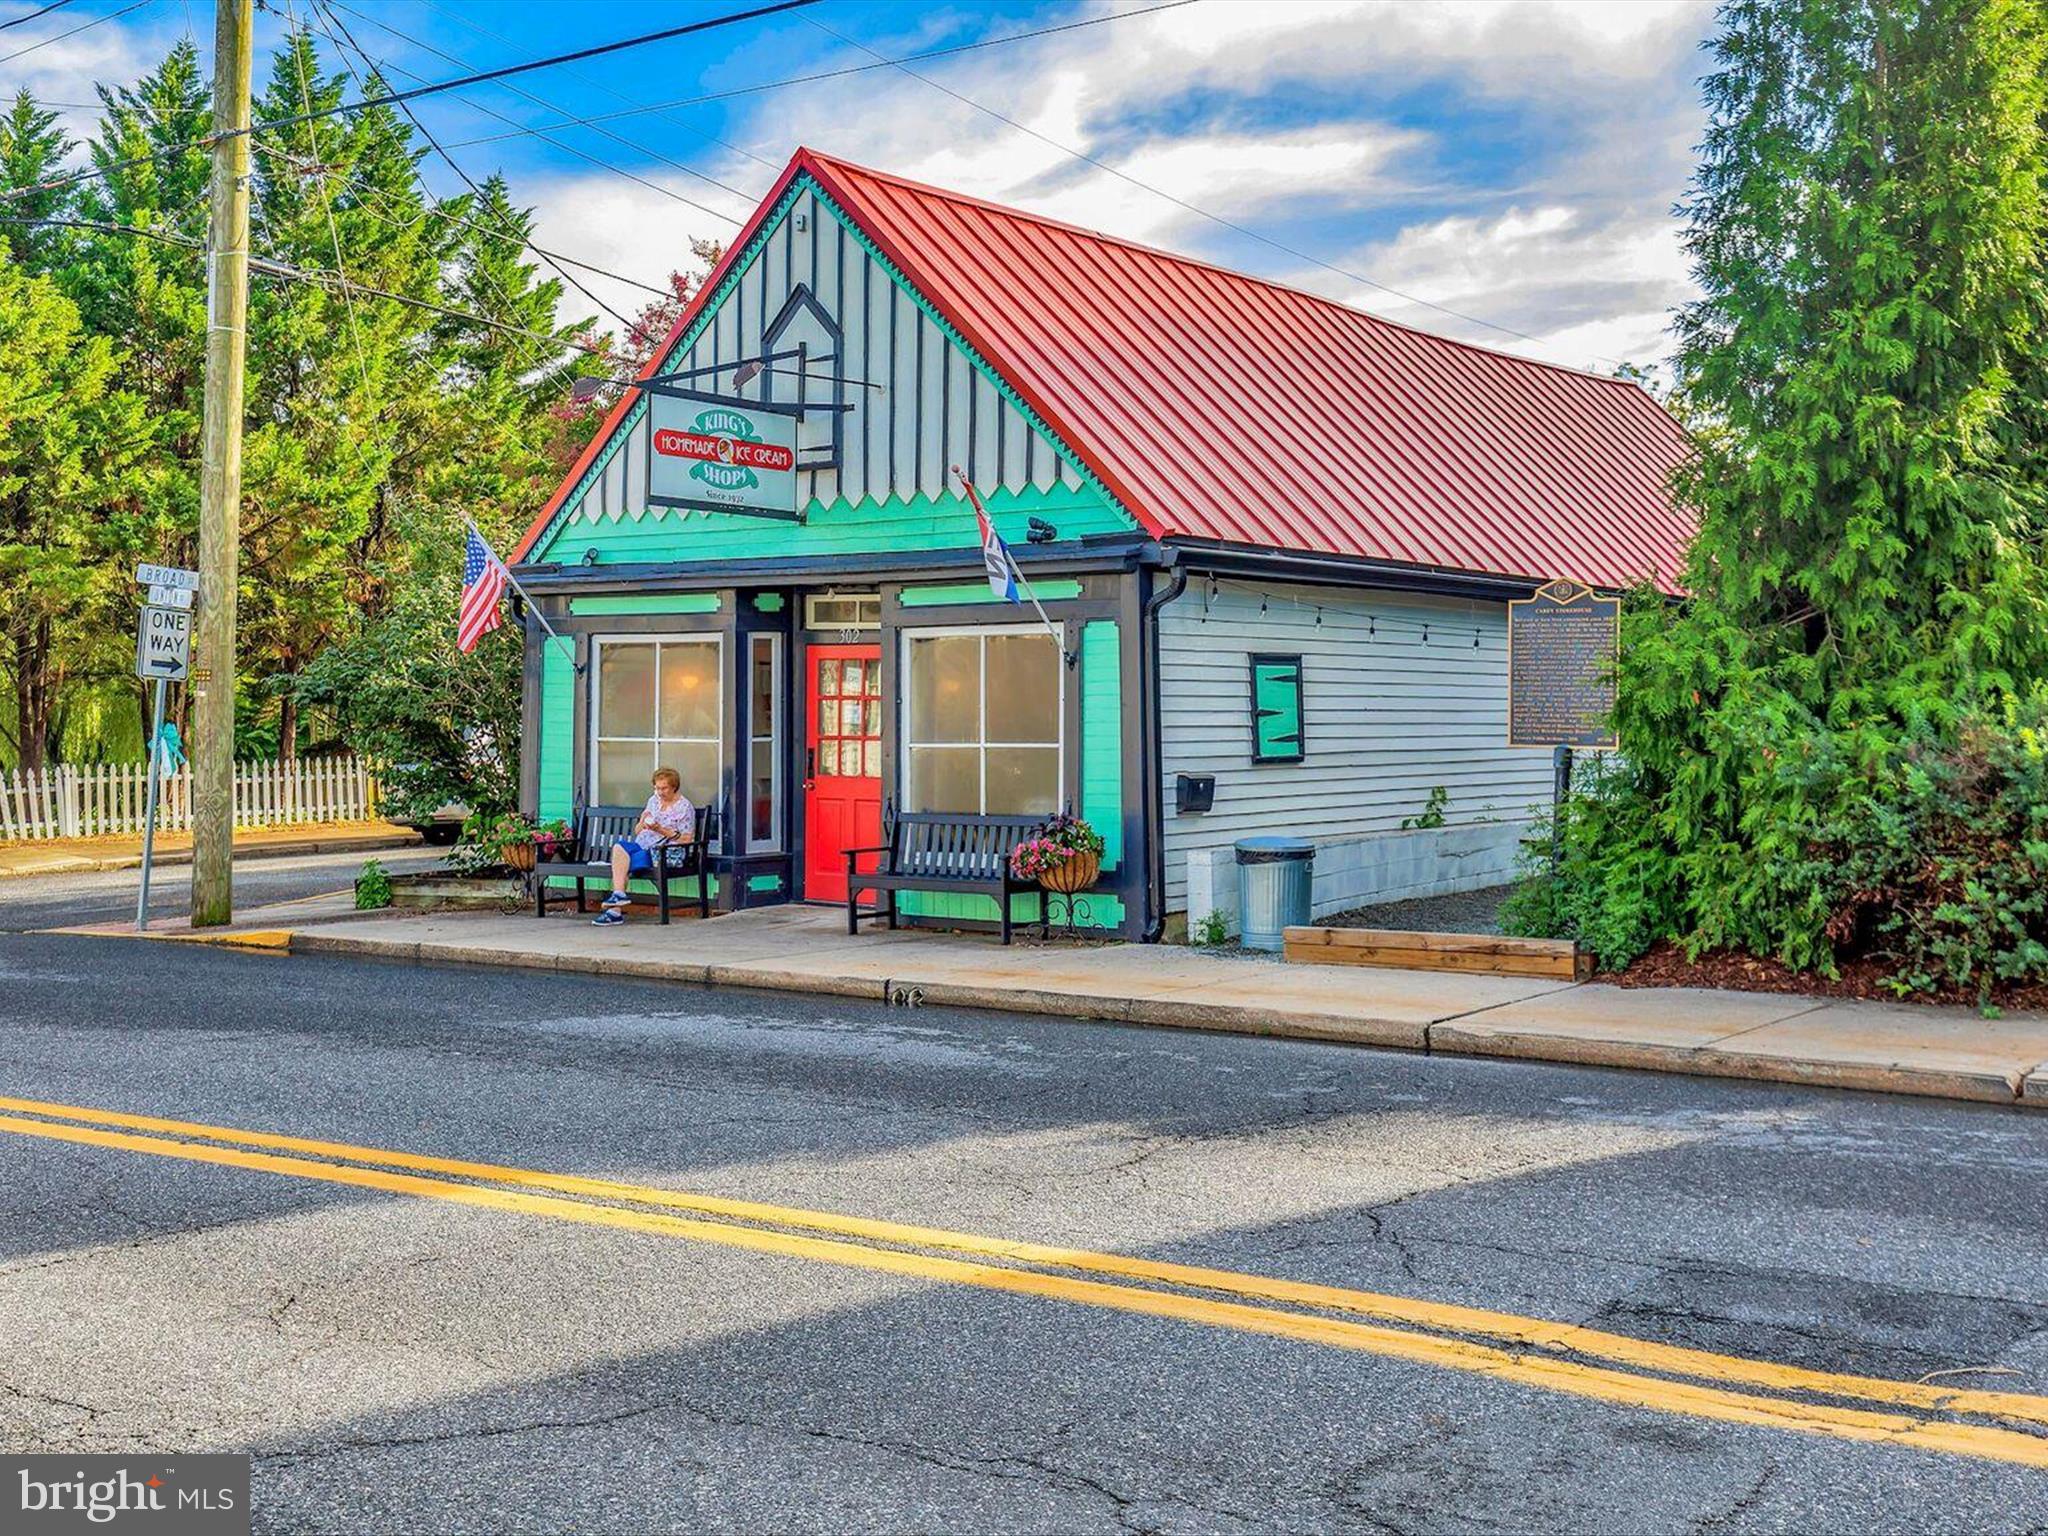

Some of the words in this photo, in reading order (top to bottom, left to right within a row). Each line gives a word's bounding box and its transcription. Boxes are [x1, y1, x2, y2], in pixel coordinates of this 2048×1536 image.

[704, 413, 747, 436] KING'S
[661, 435, 717, 457] HOMEMADE
[735, 445, 751, 461] ICE
[754, 448, 788, 466] CREAM
[703, 463, 747, 486] SHOPS
[705, 489, 726, 501] Since
[146, 568, 186, 586] BROAD
[152, 612, 186, 631] ONE
[151, 634, 185, 653] WAY
[839, 628, 860, 644] 302
